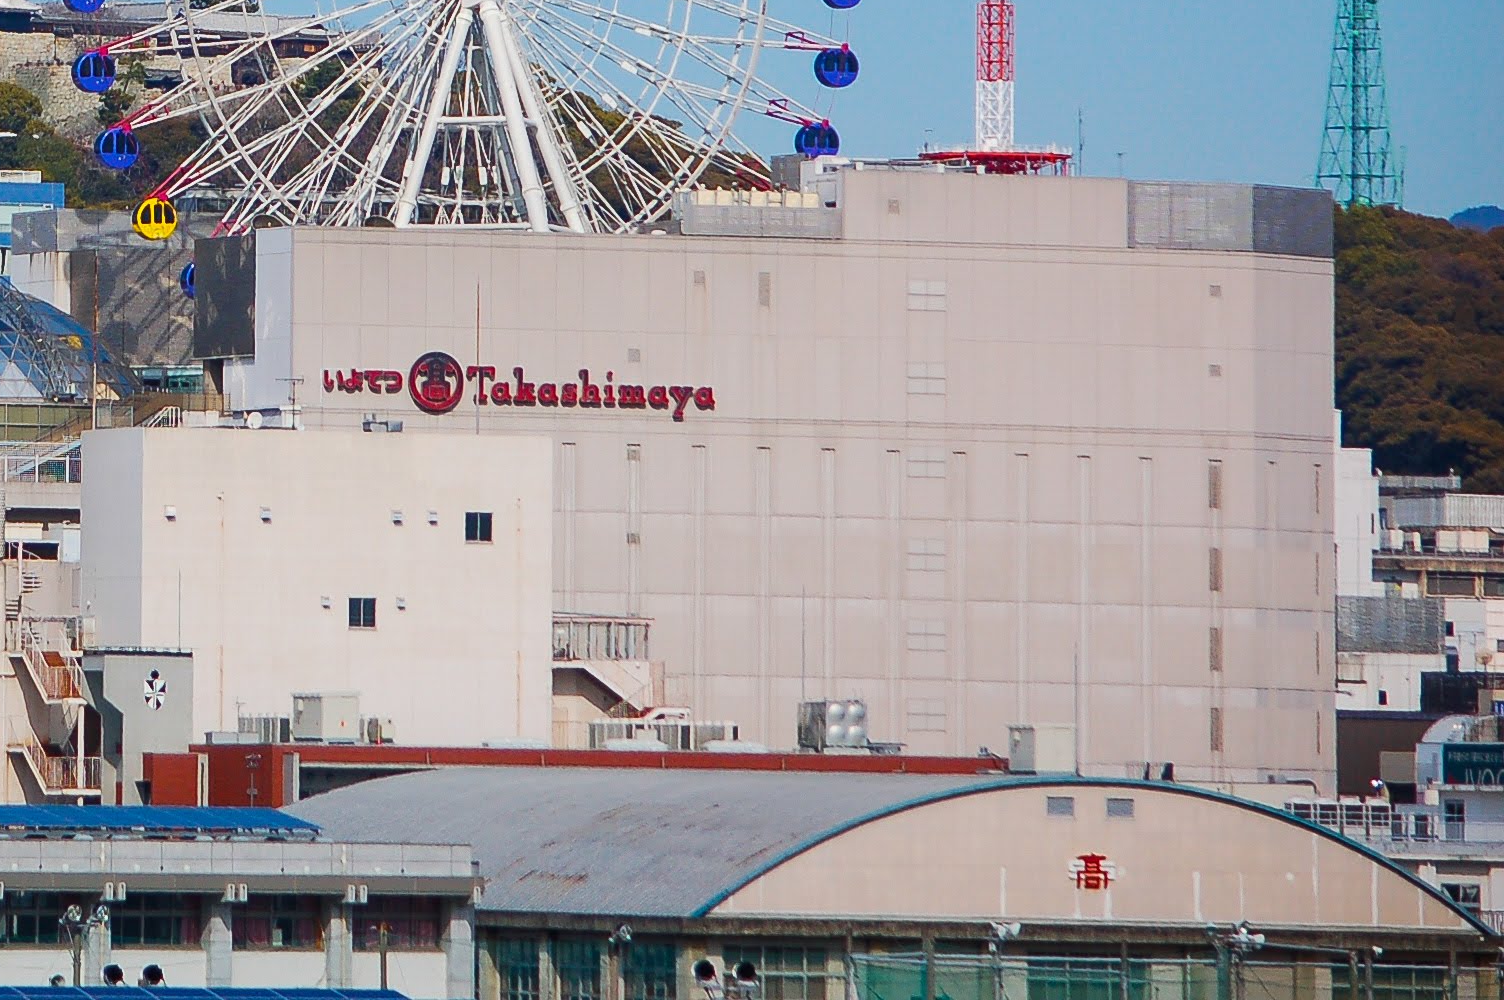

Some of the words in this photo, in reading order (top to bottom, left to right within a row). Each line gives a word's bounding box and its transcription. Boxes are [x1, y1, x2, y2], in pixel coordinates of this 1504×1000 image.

[323, 368, 403, 394] いよてつ
[466, 366, 715, 422] Takashimaya
